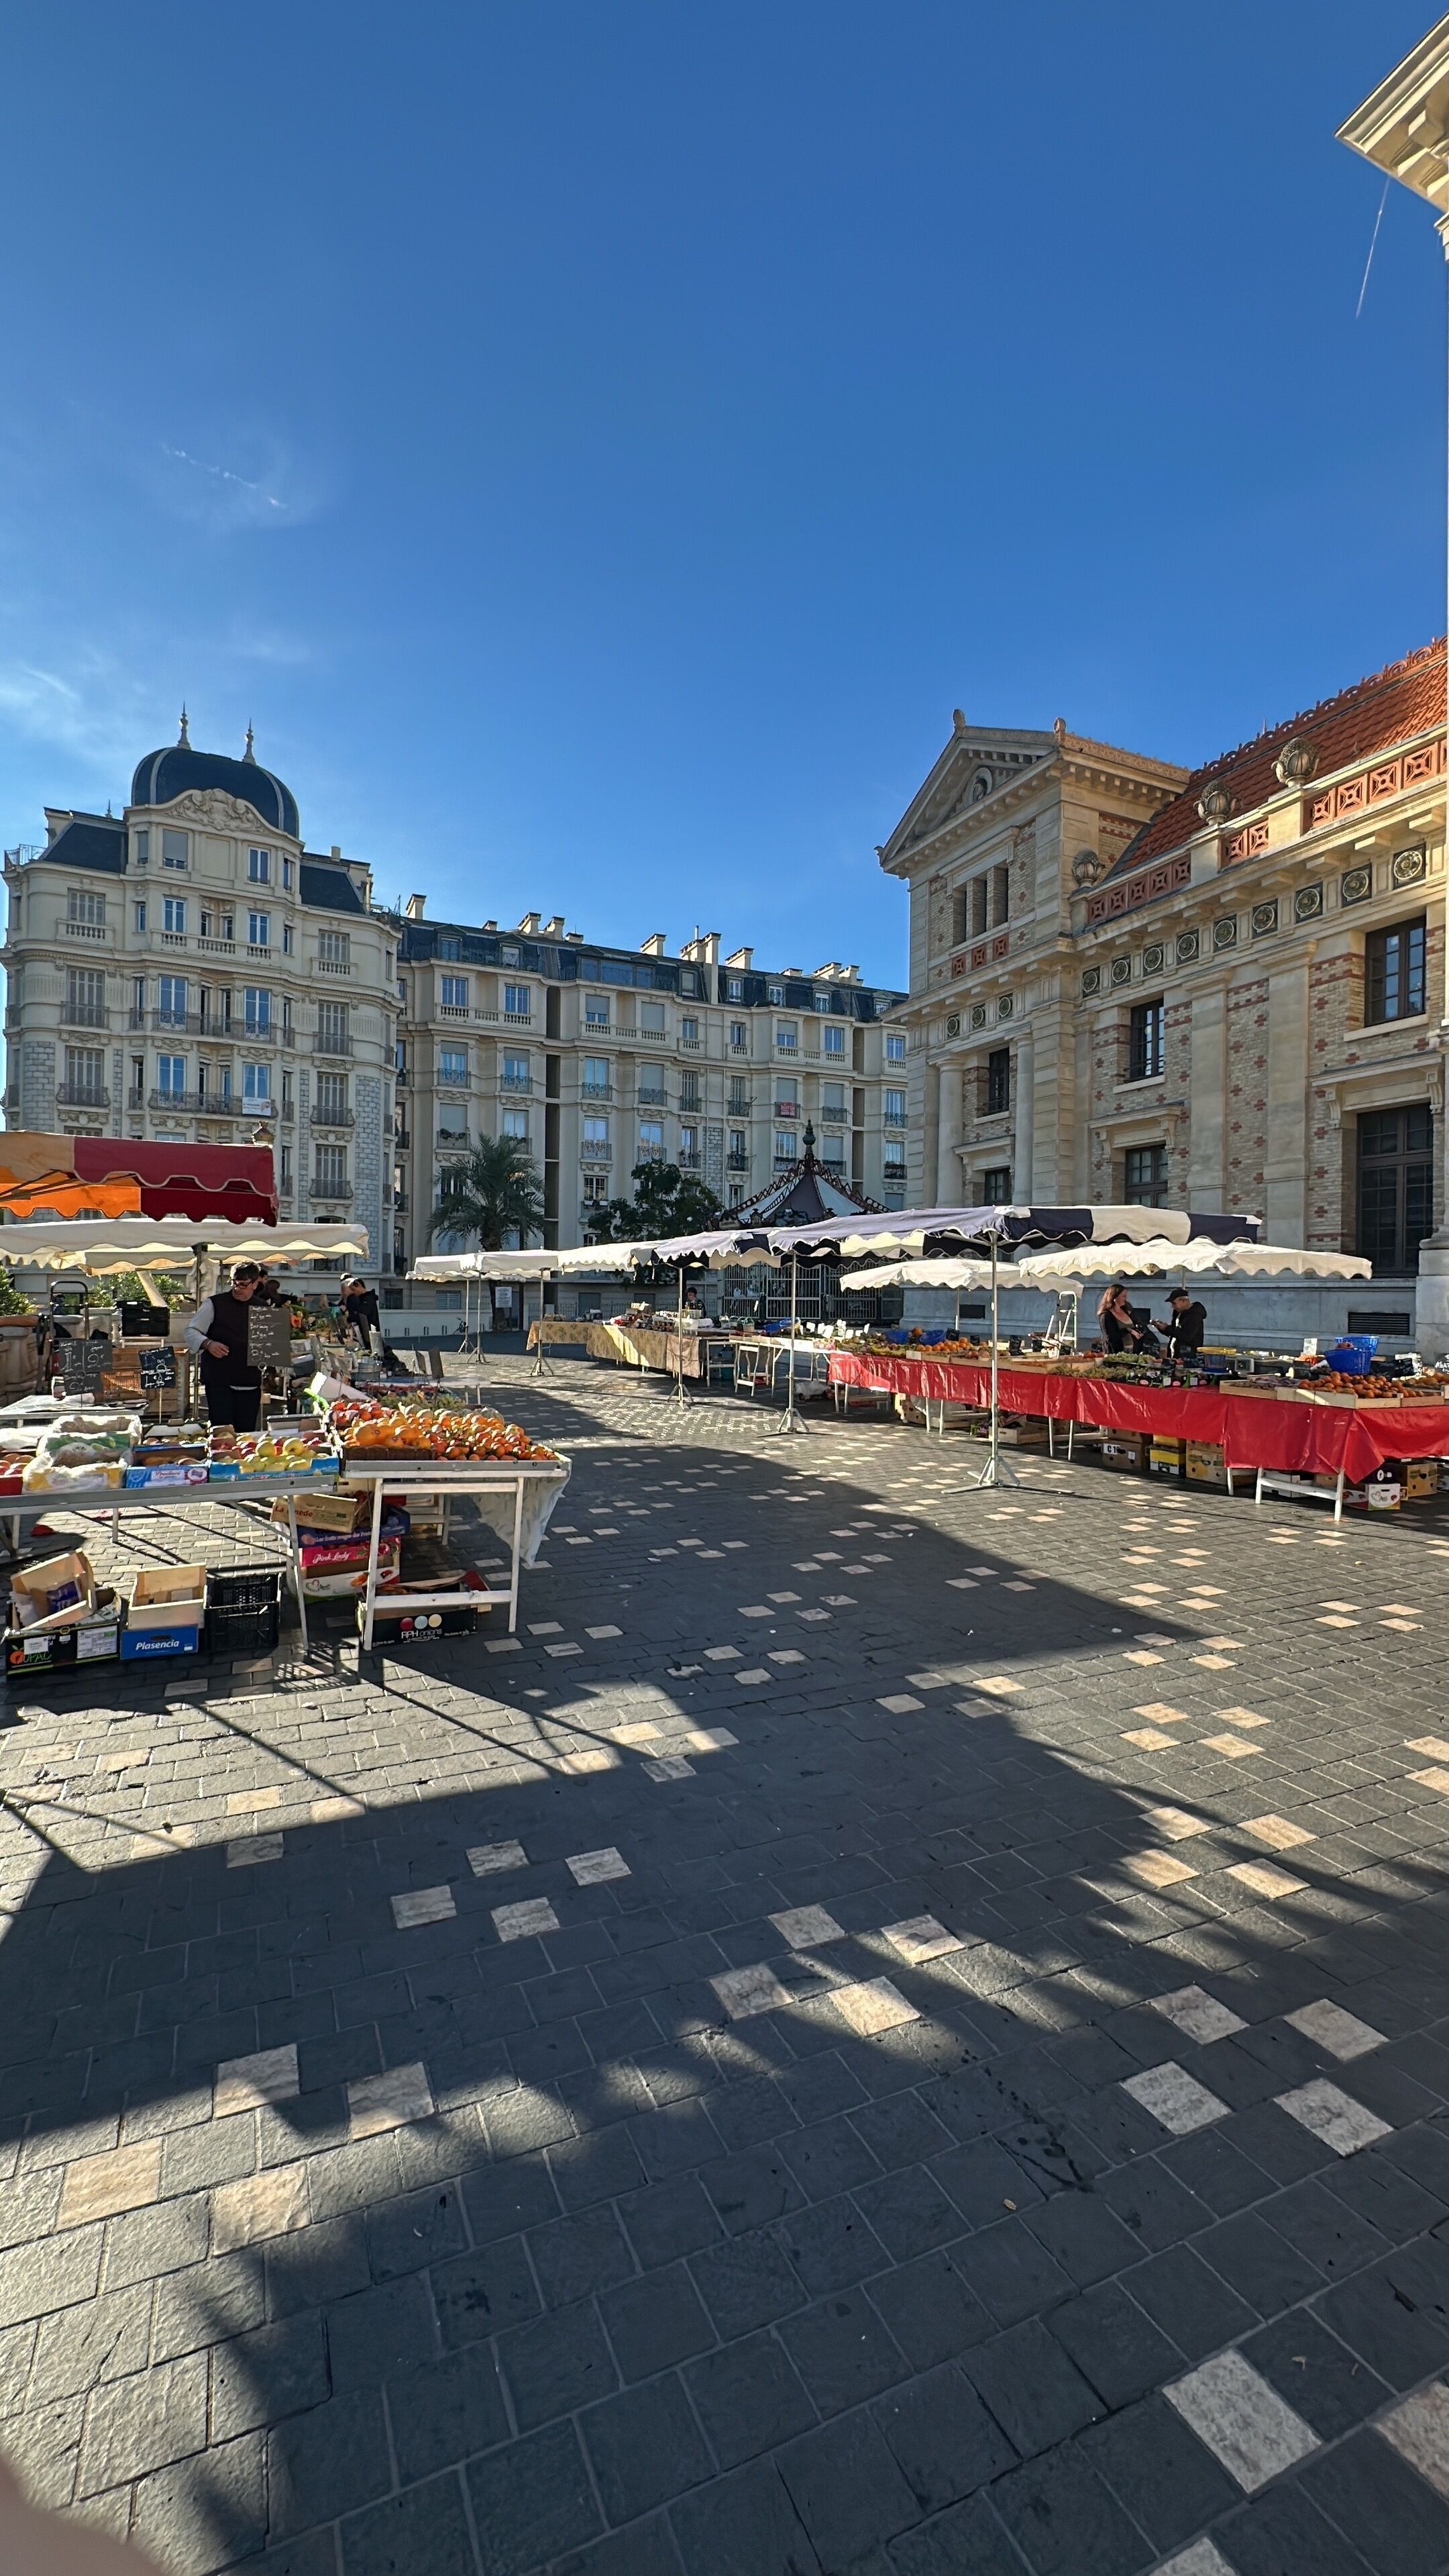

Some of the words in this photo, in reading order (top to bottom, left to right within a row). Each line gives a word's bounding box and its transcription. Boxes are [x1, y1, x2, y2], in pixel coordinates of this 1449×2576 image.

[1108, 1445, 1112, 1453] C
[313, 1553, 331, 1564] Pink
[331, 1551, 352, 1562] Lady
[419, 1628, 442, 1637] onions
[136, 1640, 180, 1650] Plasencia
